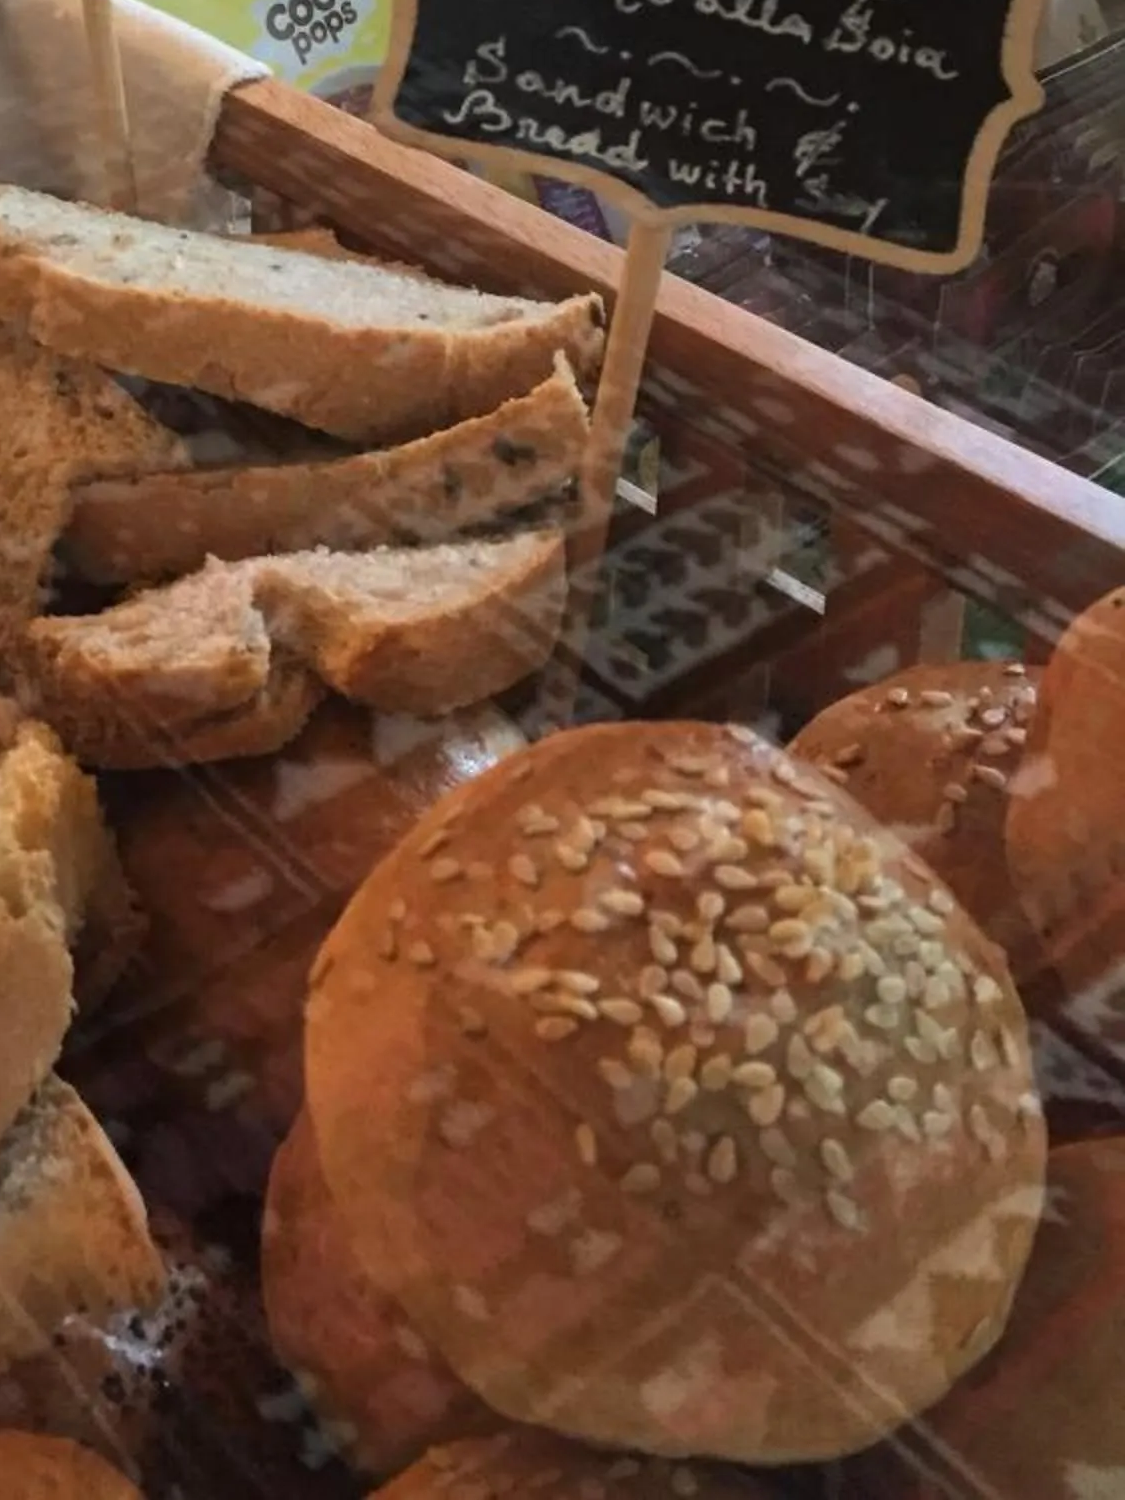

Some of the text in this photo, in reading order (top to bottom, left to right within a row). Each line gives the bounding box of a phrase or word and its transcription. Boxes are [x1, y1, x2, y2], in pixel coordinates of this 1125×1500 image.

[290, 0, 359, 66] pops
[442, 88, 649, 172] Bread
[668, 157, 768, 209] with
[463, 40, 757, 151] Sandwich
